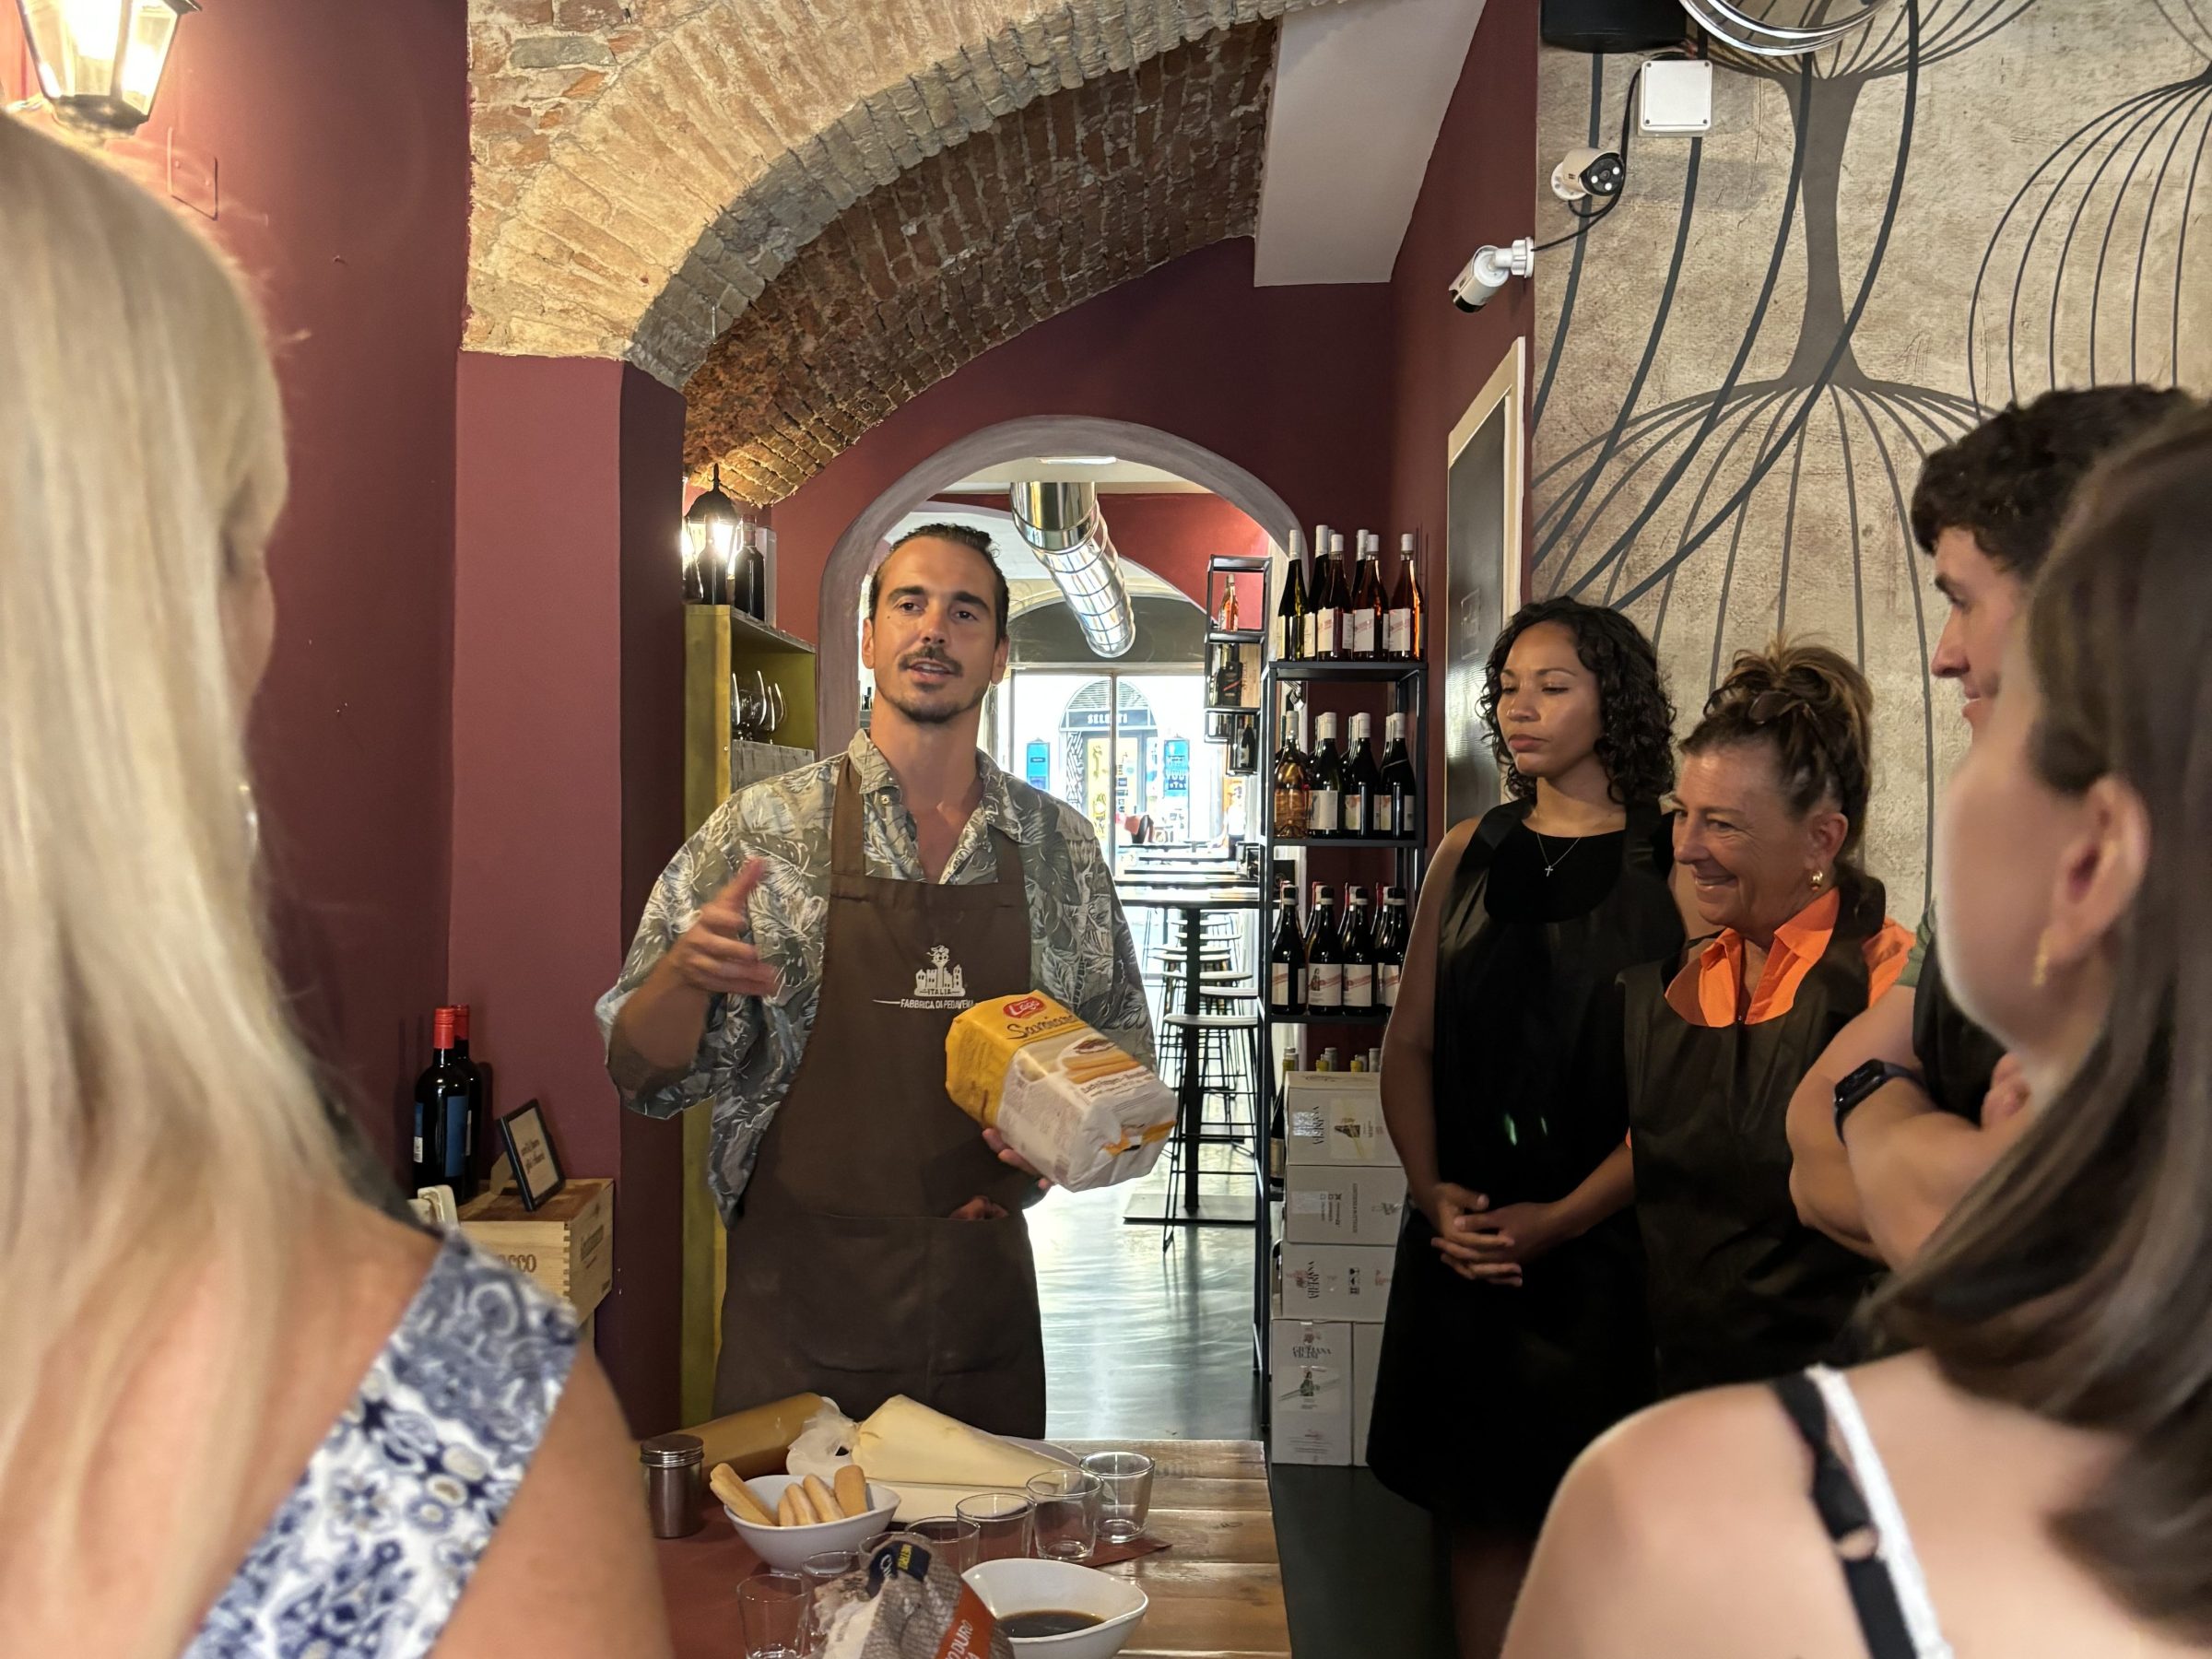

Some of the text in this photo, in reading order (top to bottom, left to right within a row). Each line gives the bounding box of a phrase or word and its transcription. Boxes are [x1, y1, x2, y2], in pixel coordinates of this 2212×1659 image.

[900, 999, 935, 1009] FABBRICA
[935, 1000, 944, 1009] DI
[950, 1619, 974, 1656] DURO
